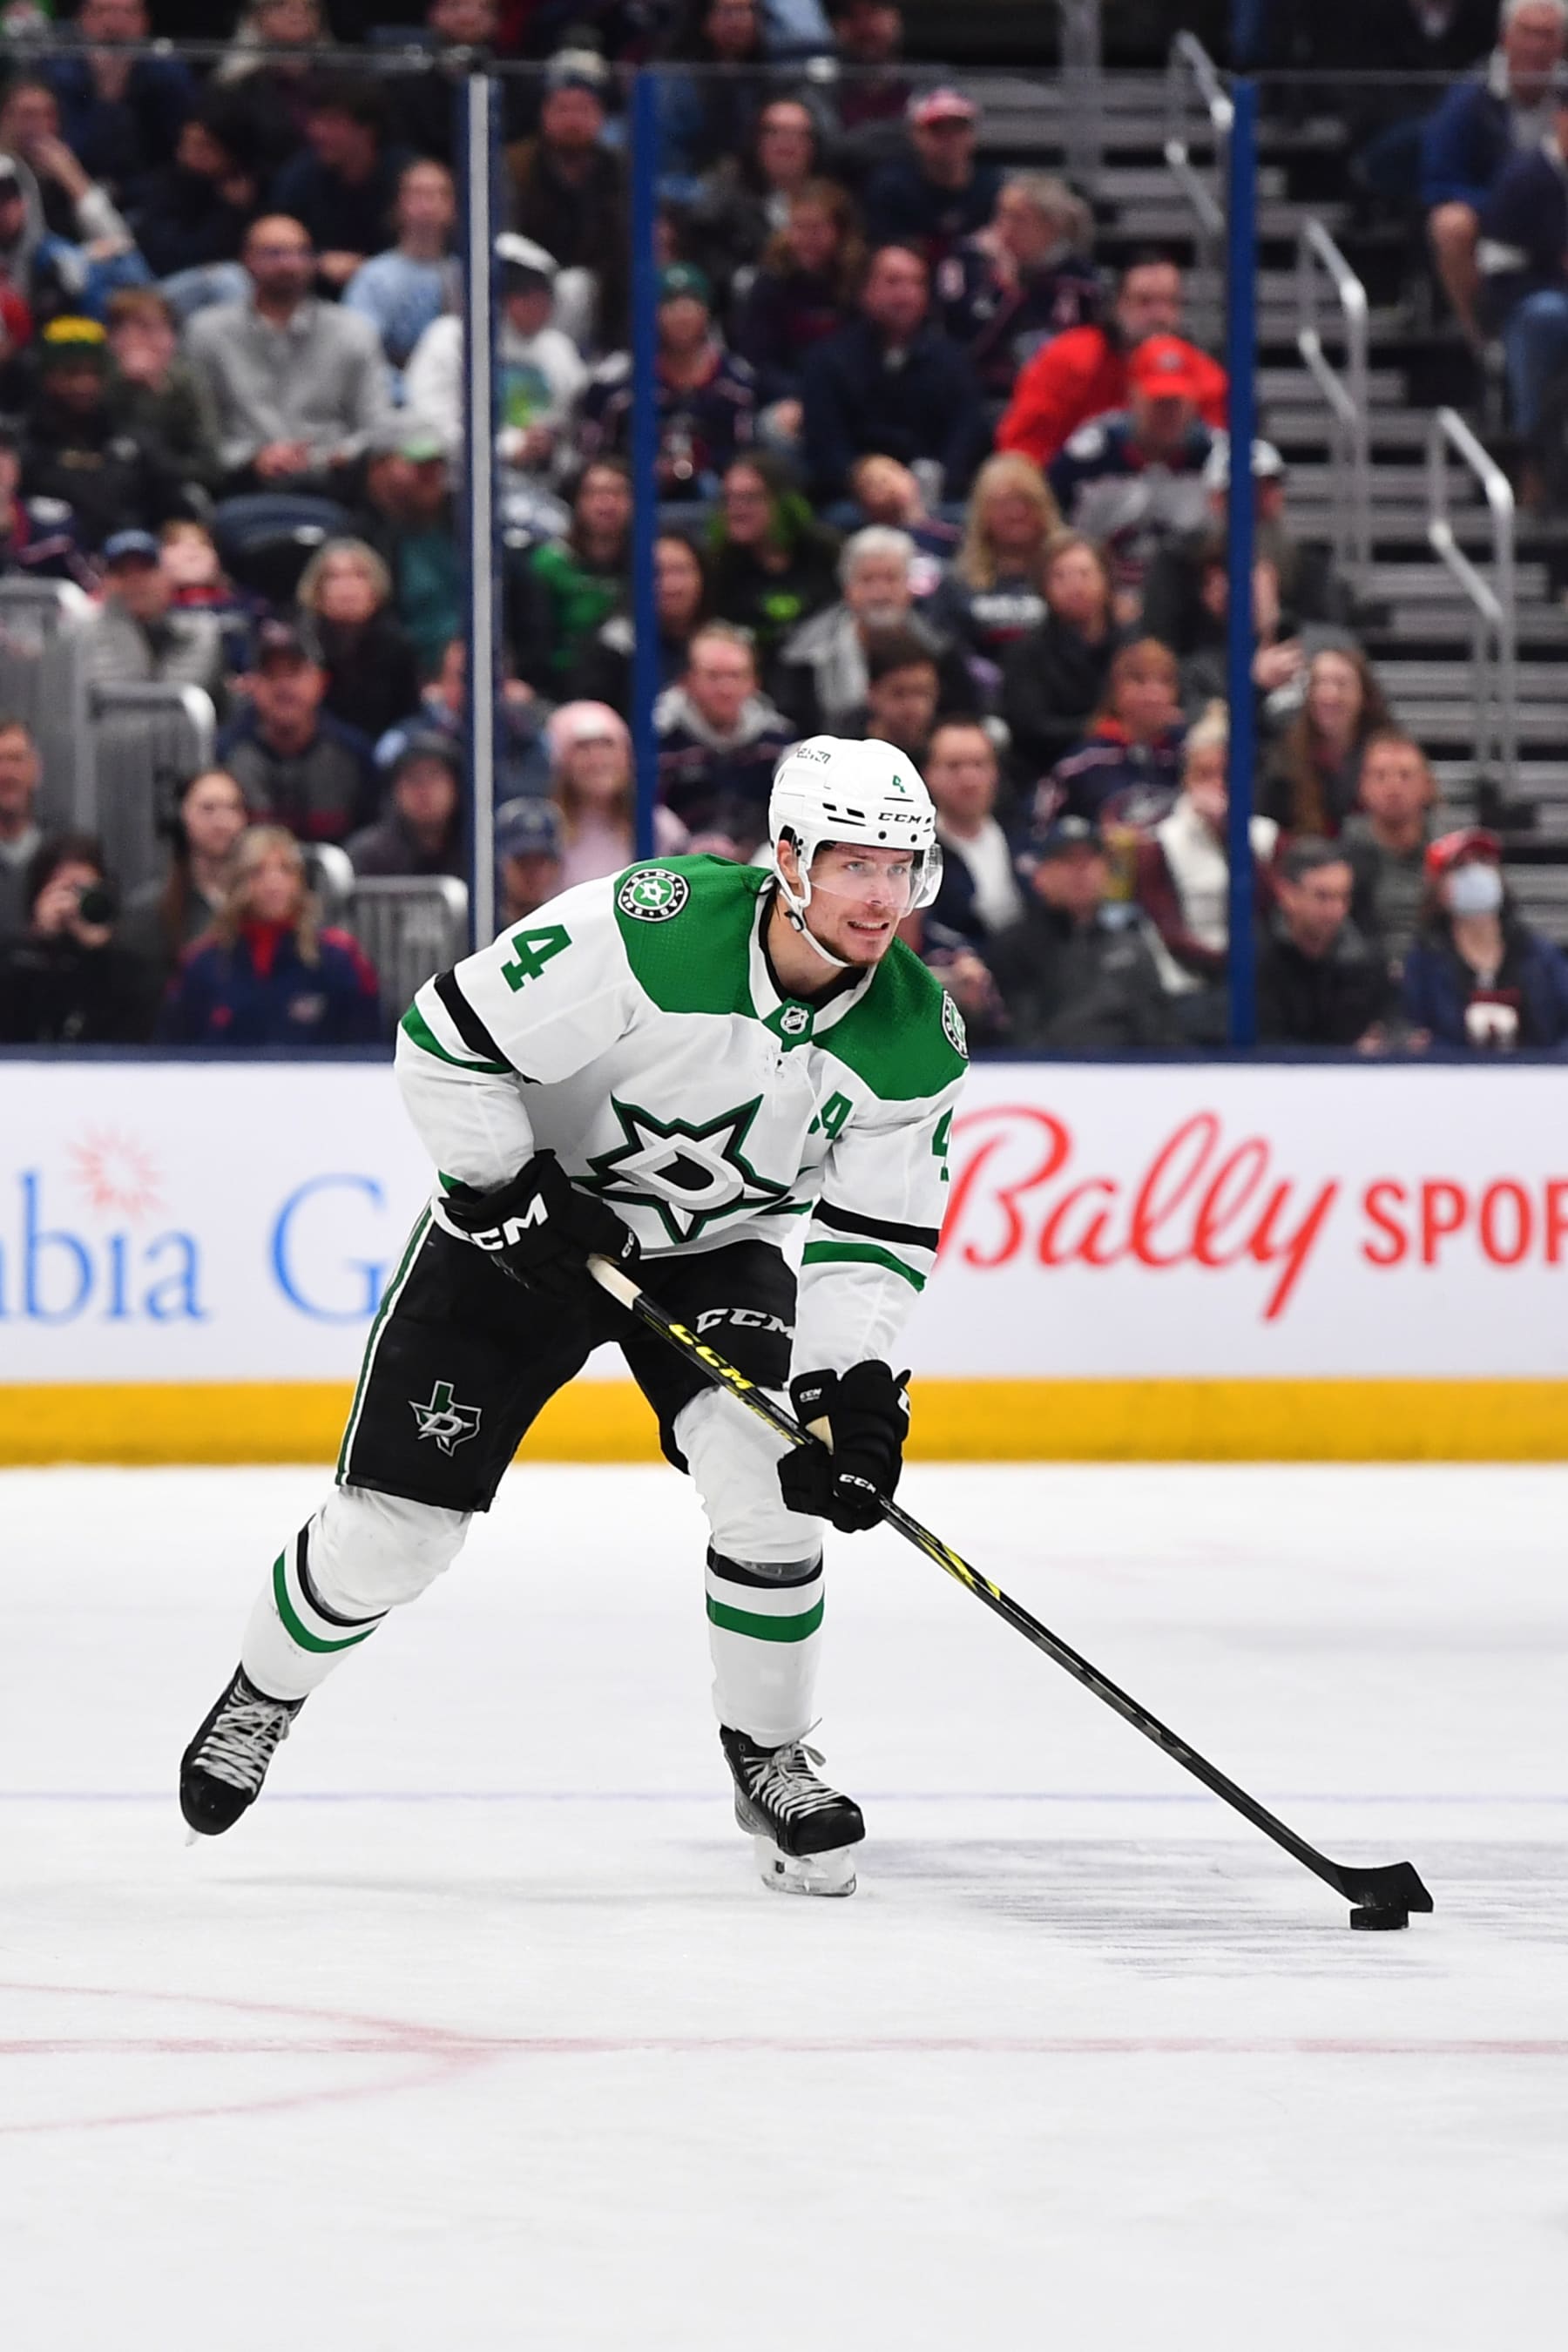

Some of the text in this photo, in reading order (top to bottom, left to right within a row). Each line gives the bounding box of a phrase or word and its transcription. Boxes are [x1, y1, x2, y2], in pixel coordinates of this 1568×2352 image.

[892, 774, 906, 794] 4
[878, 812, 923, 824] CCM
[500, 923, 572, 993] 4
[929, 1104, 1342, 1322] Bally
[0, 1169, 206, 1326] bia
[668, 1323, 757, 1390] CCM
[696, 1308, 795, 1340] CCM
